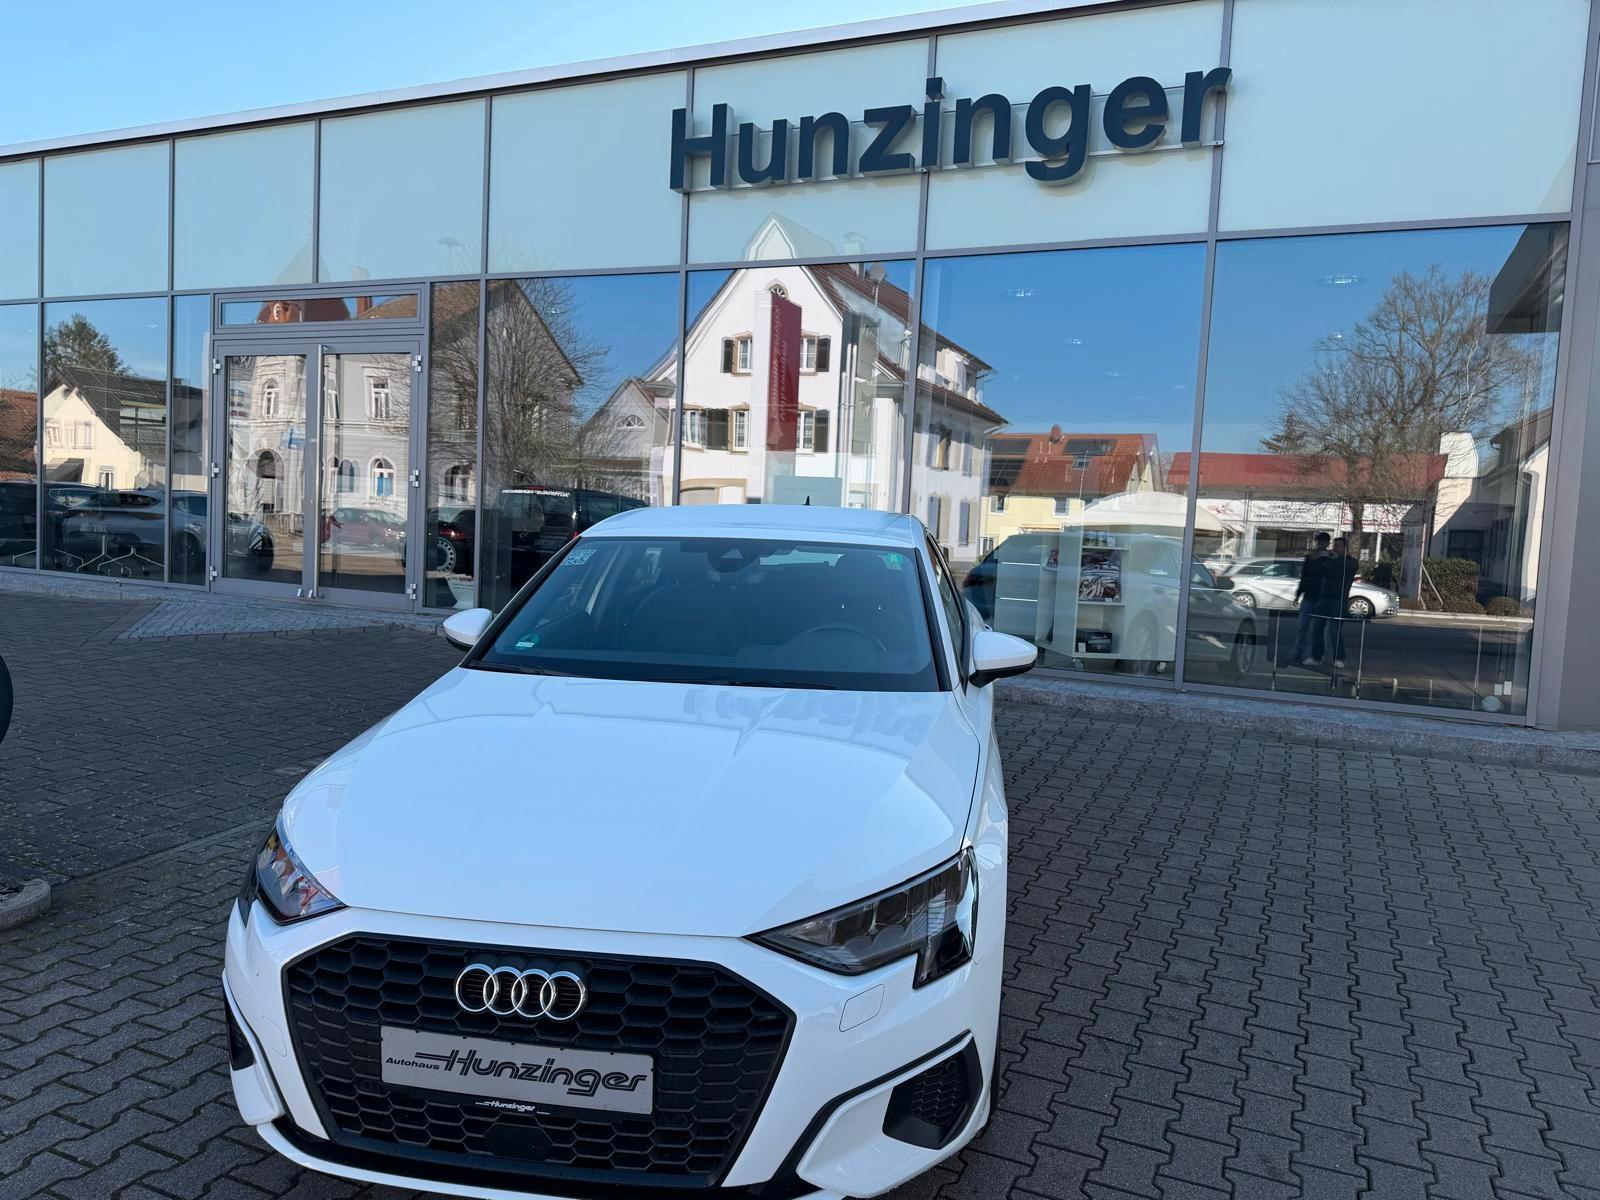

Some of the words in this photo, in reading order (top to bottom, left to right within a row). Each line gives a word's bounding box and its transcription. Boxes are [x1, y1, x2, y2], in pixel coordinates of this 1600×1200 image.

[671, 68, 1231, 191] Hunzinger
[385, 1057, 439, 1071] Autohaus
[415, 1049, 648, 1097] Hunzinger
[484, 1100, 536, 1112] Hunzinger
